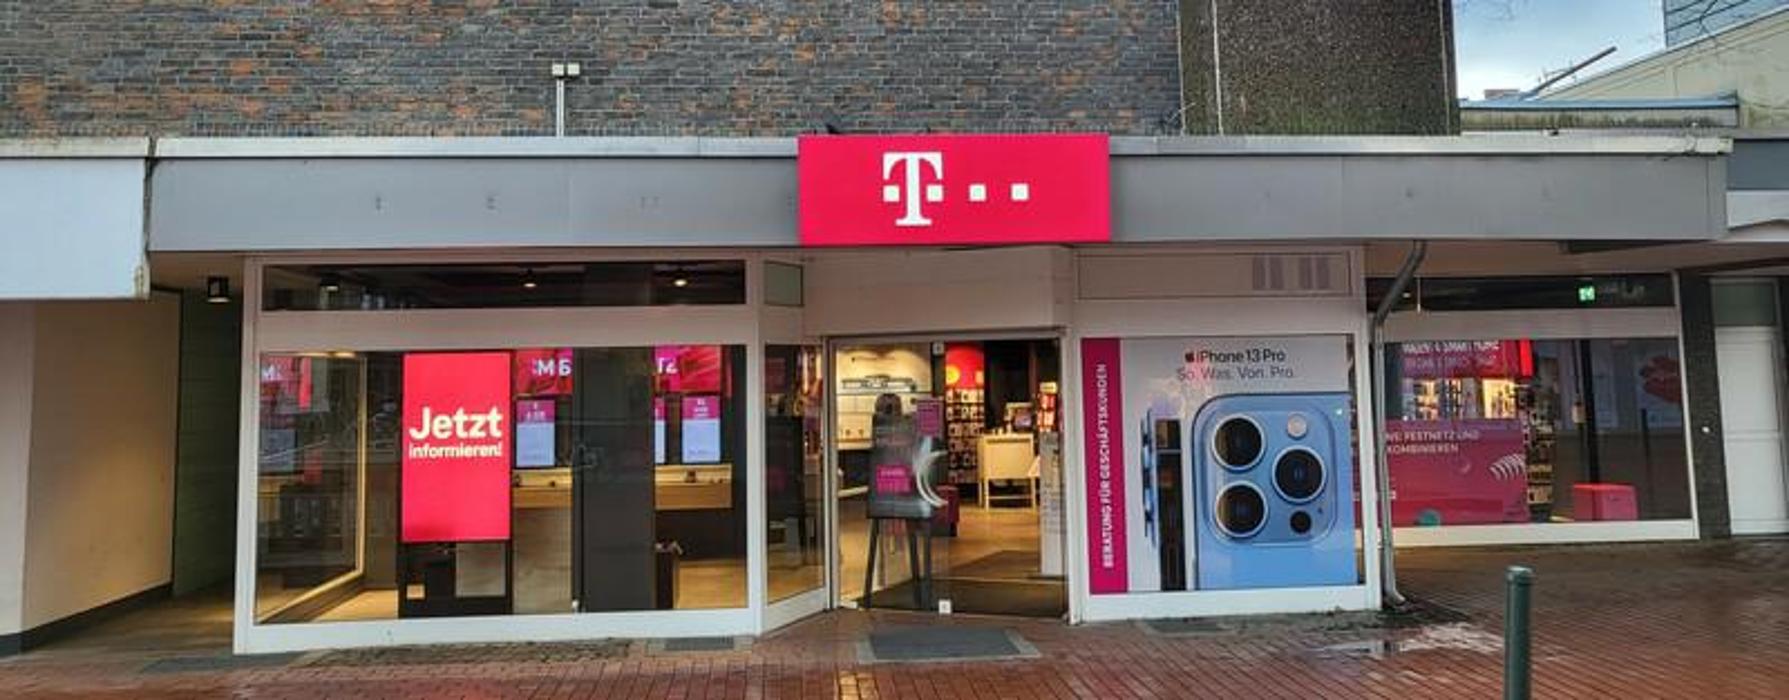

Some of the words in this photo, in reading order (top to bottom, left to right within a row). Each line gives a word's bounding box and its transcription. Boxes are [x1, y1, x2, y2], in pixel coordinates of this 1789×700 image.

[1196, 350, 1243, 363] iPhone
[1245, 349, 1260, 363] 13
[1263, 348, 1286, 362] Pro
[409, 406, 502, 440] Jetzt
[1096, 363, 1110, 479] GESCHÄFTSKUNDEN
[409, 441, 502, 458] informieren!
[1098, 480, 1112, 504] FÜR
[1101, 505, 1114, 568] BERATUNG
